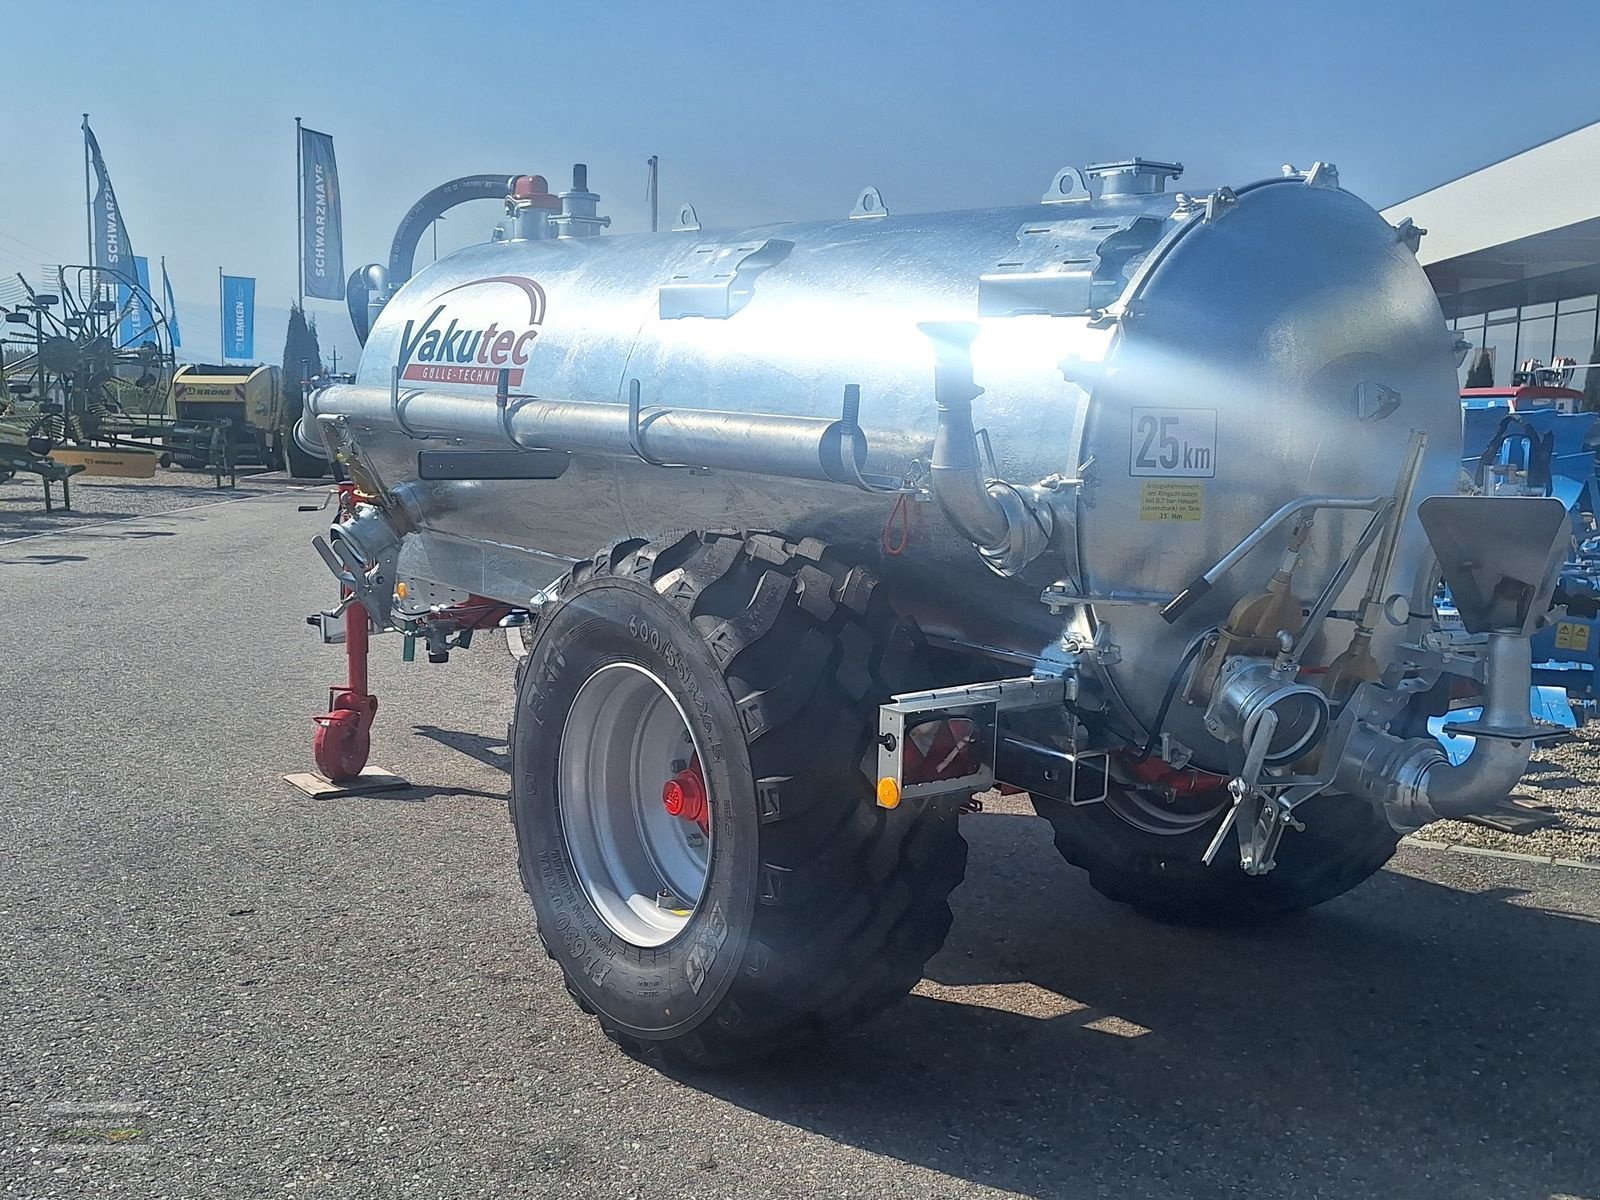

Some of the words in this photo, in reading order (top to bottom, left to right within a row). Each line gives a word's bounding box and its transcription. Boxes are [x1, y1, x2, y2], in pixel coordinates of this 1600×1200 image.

[315, 163, 326, 278] SCHWARZMAYR
[235, 301, 245, 342] LEMKEN
[398, 304, 538, 380] Vakutec
[196, 388, 233, 396] KRONE
[1136, 414, 1180, 470] 25
[1183, 440, 1211, 470] km
[1171, 512, 1183, 520] Nm
